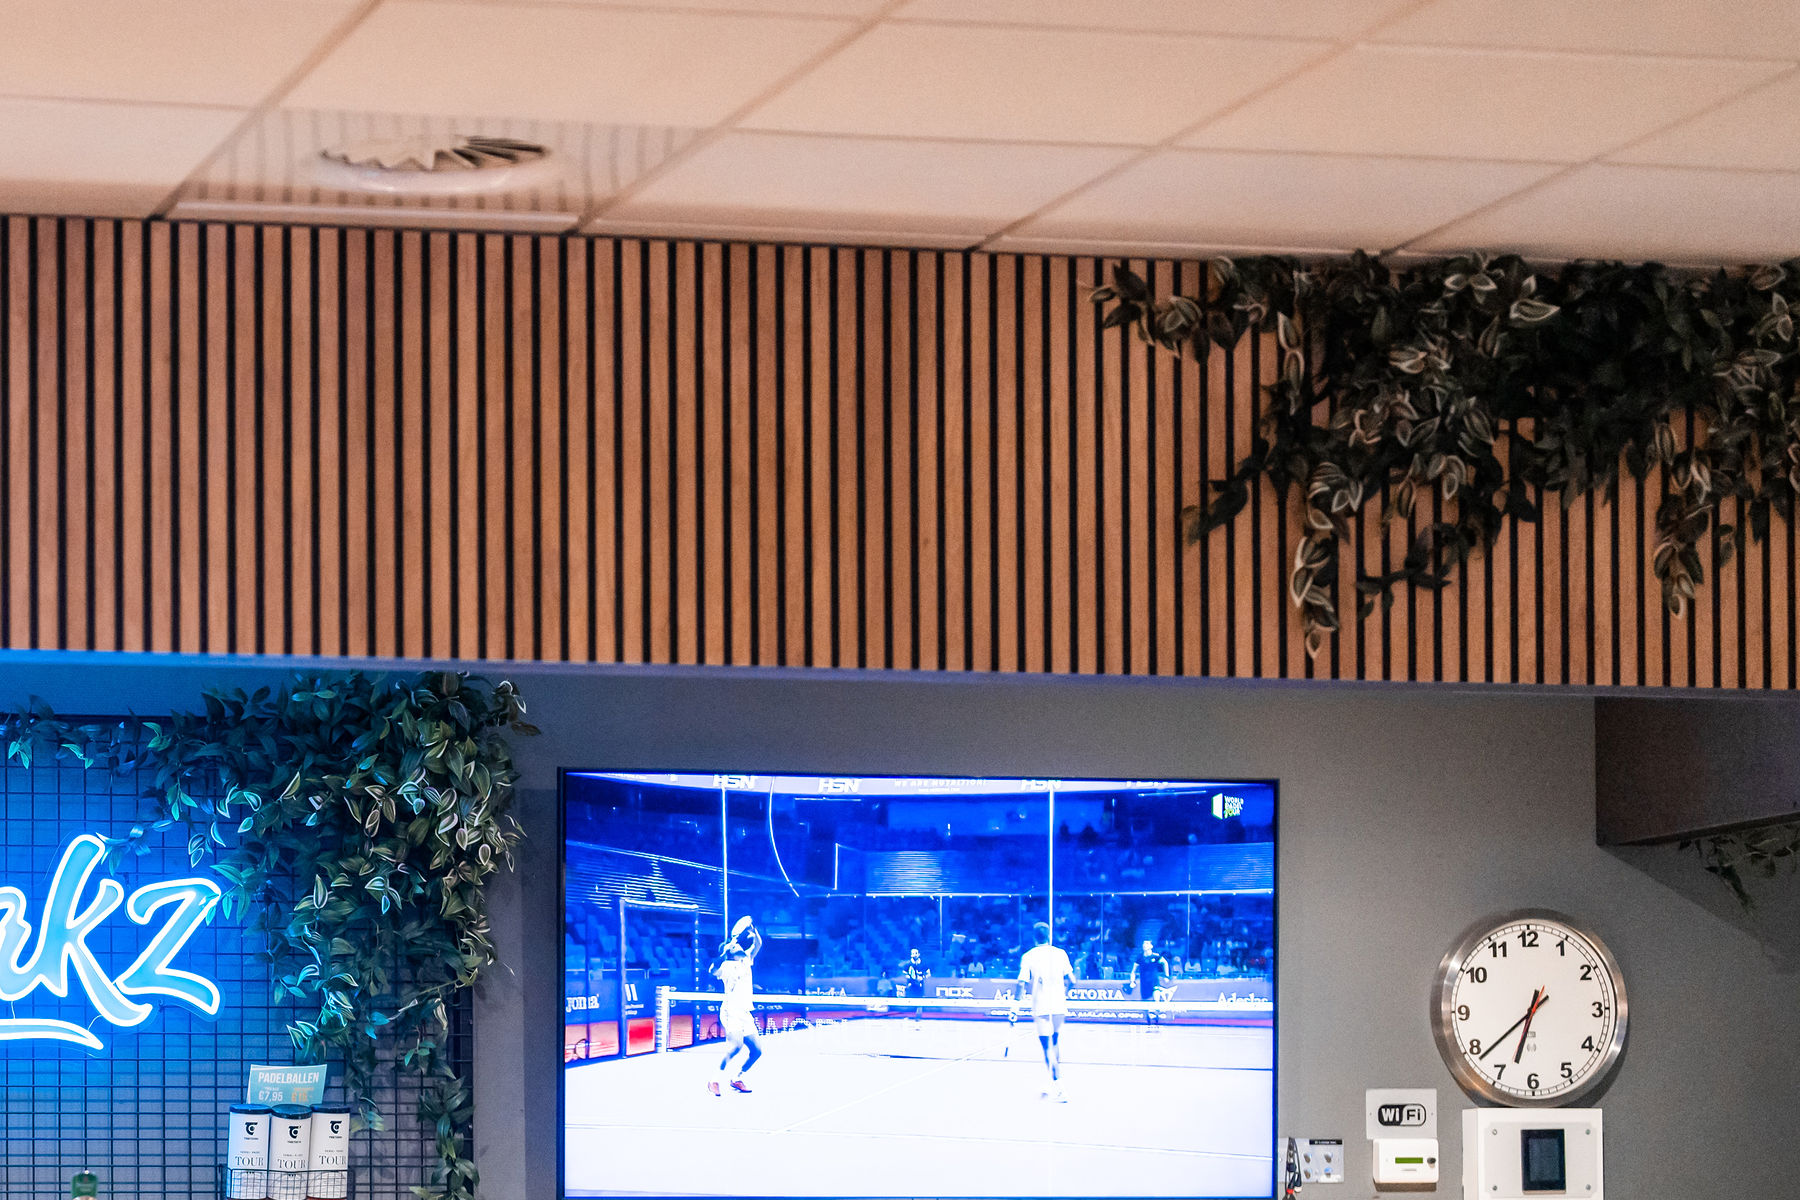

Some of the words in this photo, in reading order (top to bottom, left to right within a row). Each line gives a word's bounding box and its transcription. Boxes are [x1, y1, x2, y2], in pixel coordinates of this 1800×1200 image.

[1517, 930, 1539, 948] 12
[1488, 941, 1507, 958] 11
[1555, 940, 1566, 957] 1
[1465, 966, 1488, 984] 10
[1579, 964, 1592, 981] 2
[1066, 988, 1124, 1001] CTORIA
[1457, 1004, 1471, 1021] 9
[1591, 1001, 1604, 1018] 3
[1468, 1038, 1482, 1055] 8
[1580, 1035, 1594, 1052] 4
[258, 1071, 320, 1084] PADELBALLEN
[1493, 1063, 1507, 1081] 7
[1560, 1061, 1573, 1079] 5
[1526, 1073, 1540, 1090] 6
[235, 1156, 264, 1167] TOUR
[277, 1158, 306, 1169] TOUR
[318, 1155, 346, 1166] TOUR
